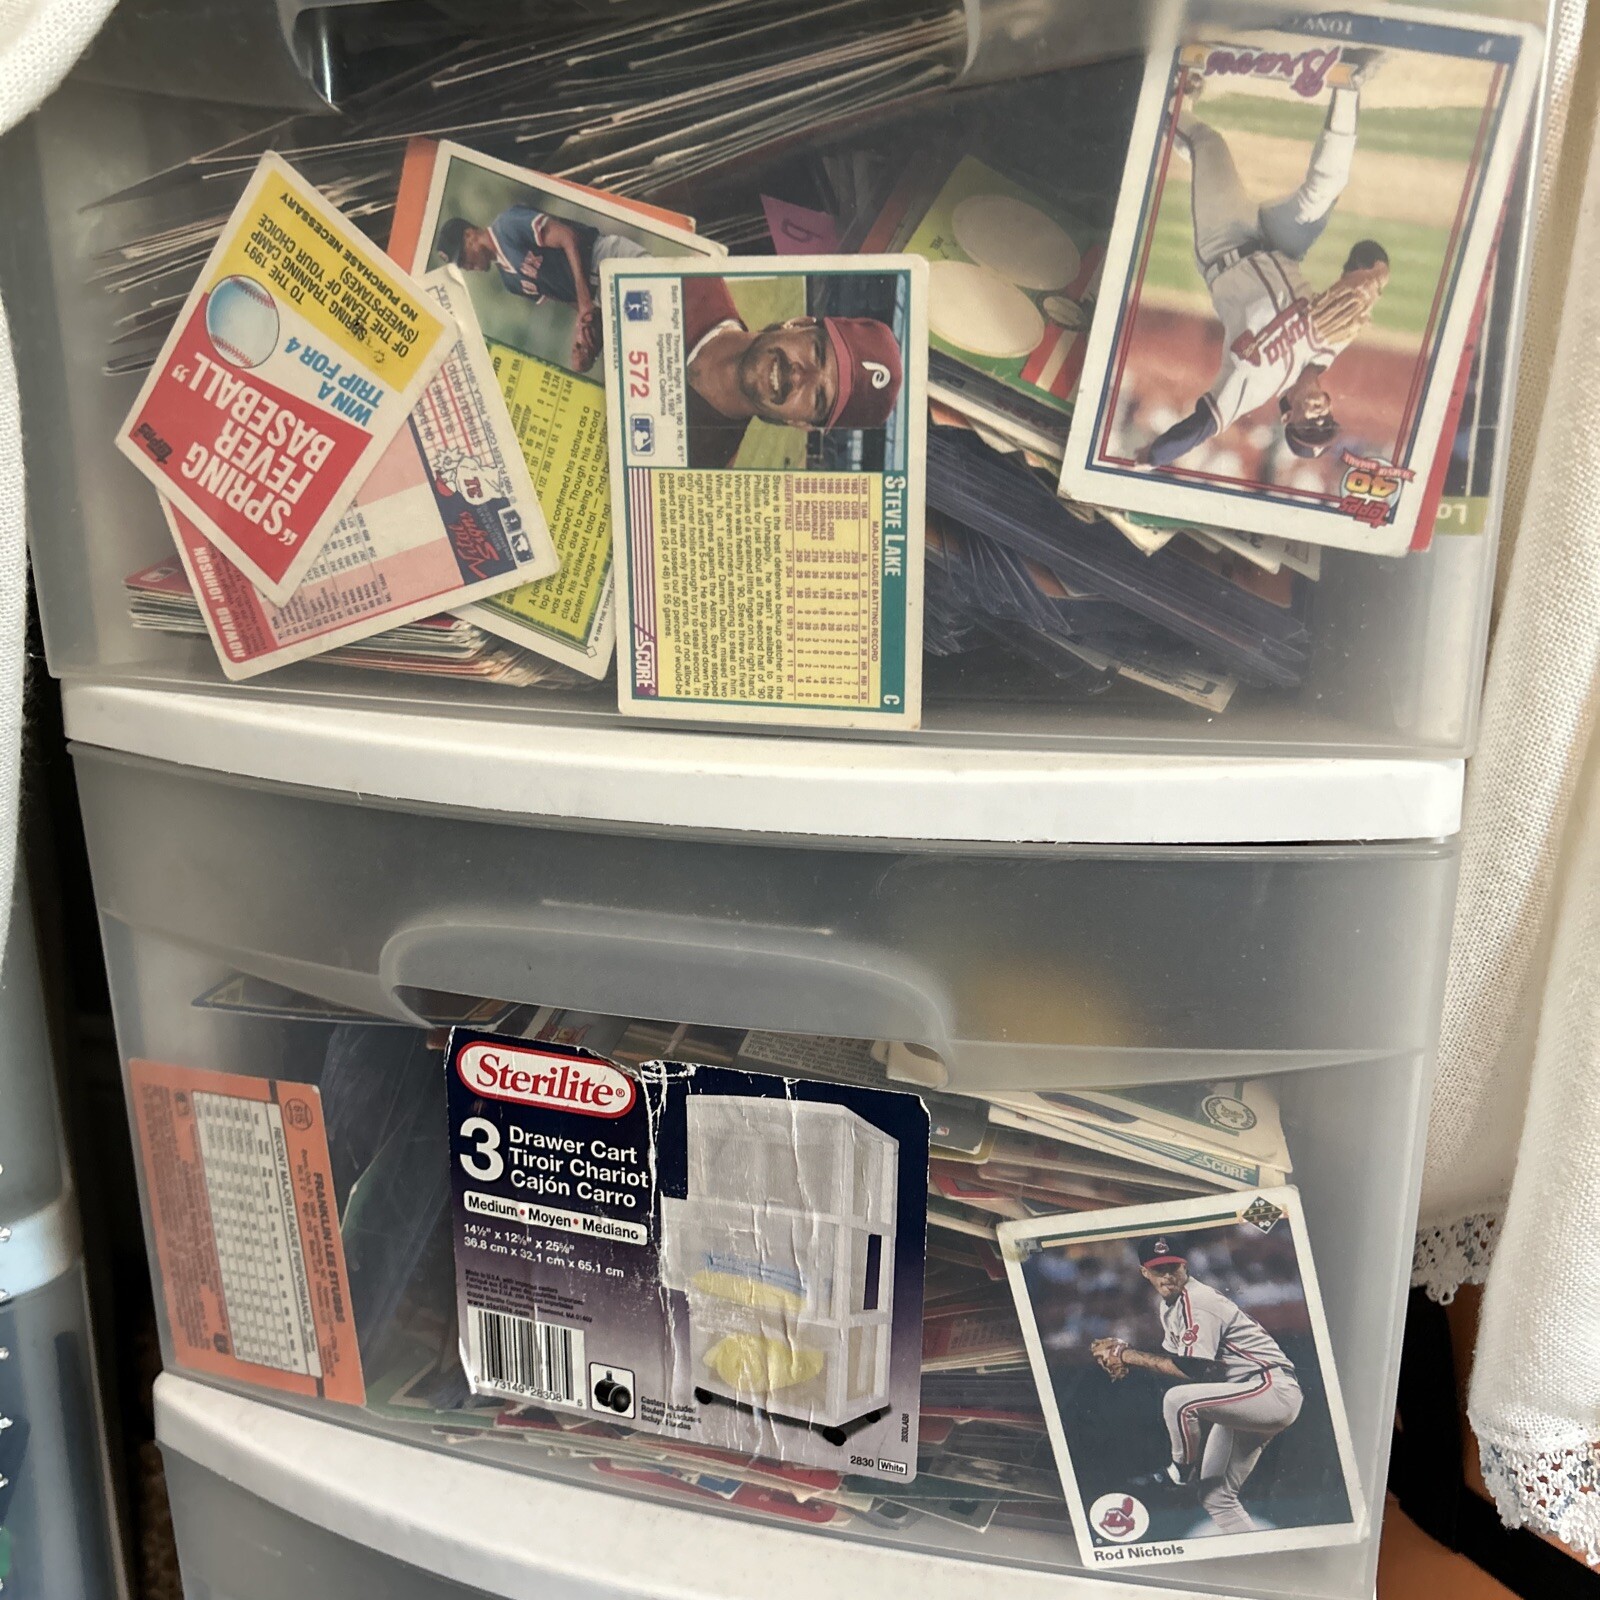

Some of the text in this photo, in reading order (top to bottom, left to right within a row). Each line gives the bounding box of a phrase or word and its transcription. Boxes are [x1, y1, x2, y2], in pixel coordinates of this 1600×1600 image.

[1201, 30, 1340, 100] Braves
[242, 241, 306, 304] TO THE 1991
[279, 192, 419, 321] NO PURCHASE NECESSARY
[248, 227, 369, 341] SPRING TRAINING CAMP
[256, 213, 409, 358] OF THE TEAM OF YOUR CHOICE
[337, 266, 420, 344] (SWEEPSTAKES)
[283, 336, 384, 407] TRIP FOR 4
[628, 350, 649, 397] 572
[170, 351, 336, 472] BASEBALL”
[316, 380, 373, 426] WIN A
[431, 384, 457, 434] SLUGGING
[445, 363, 482, 448] STRIKEOUT RATIO
[422, 426, 435, 441] ON
[585, 409, 600, 444] record
[210, 417, 314, 504] FEVER
[551, 405, 590, 521] confirmed his status as a
[581, 446, 591, 461] his
[176, 440, 294, 548] “SPRING
[462, 474, 484, 501] 31
[570, 464, 587, 502] Though
[586, 474, 595, 487] on
[1343, 466, 1400, 500] 40
[573, 517, 582, 528] to
[577, 489, 592, 517] being
[584, 511, 596, 534] total
[459, 510, 499, 559] Signs
[567, 530, 579, 549] due
[191, 544, 225, 605] JOHNSON
[571, 535, 589, 577] strikeout
[571, 503, 611, 624] Eastern League was not
[539, 593, 551, 610] top
[549, 597, 560, 614] was
[567, 579, 576, 593] his
[214, 604, 246, 660] HOWARD
[883, 694, 899, 704] C
[272, 1126, 285, 1168] RECENT
[459, 1116, 504, 1181] 3
[509, 1125, 637, 1164] Drawer Cart
[279, 1169, 292, 1206] MAJOR
[509, 1147, 649, 1188] Tiroir Chariot
[510, 1169, 636, 1207] Cajón Carro
[1200, 1155, 1248, 1181] SCORE
[285, 1207, 299, 1248] LEAGUE
[468, 1196, 639, 1240] Medium Moyen Mediano
[313, 1172, 345, 1322] FRANKLIN LEE STUBBS
[464, 1237, 487, 1250] 36.8
[490, 1244, 508, 1254] cm
[546, 1256, 565, 1266] cm
[568, 1260, 575, 1268] x
[605, 1267, 624, 1278] cm
[535, 1241, 543, 1249] x
[292, 1250, 311, 1324] PERFORMANCE
[494, 1378, 524, 1394] 73149
[531, 1387, 562, 1402] 28308
[577, 1399, 583, 1407] 5
[850, 1455, 904, 1472] 2830 White
[1094, 1544, 1184, 1561] Rod Nichols
